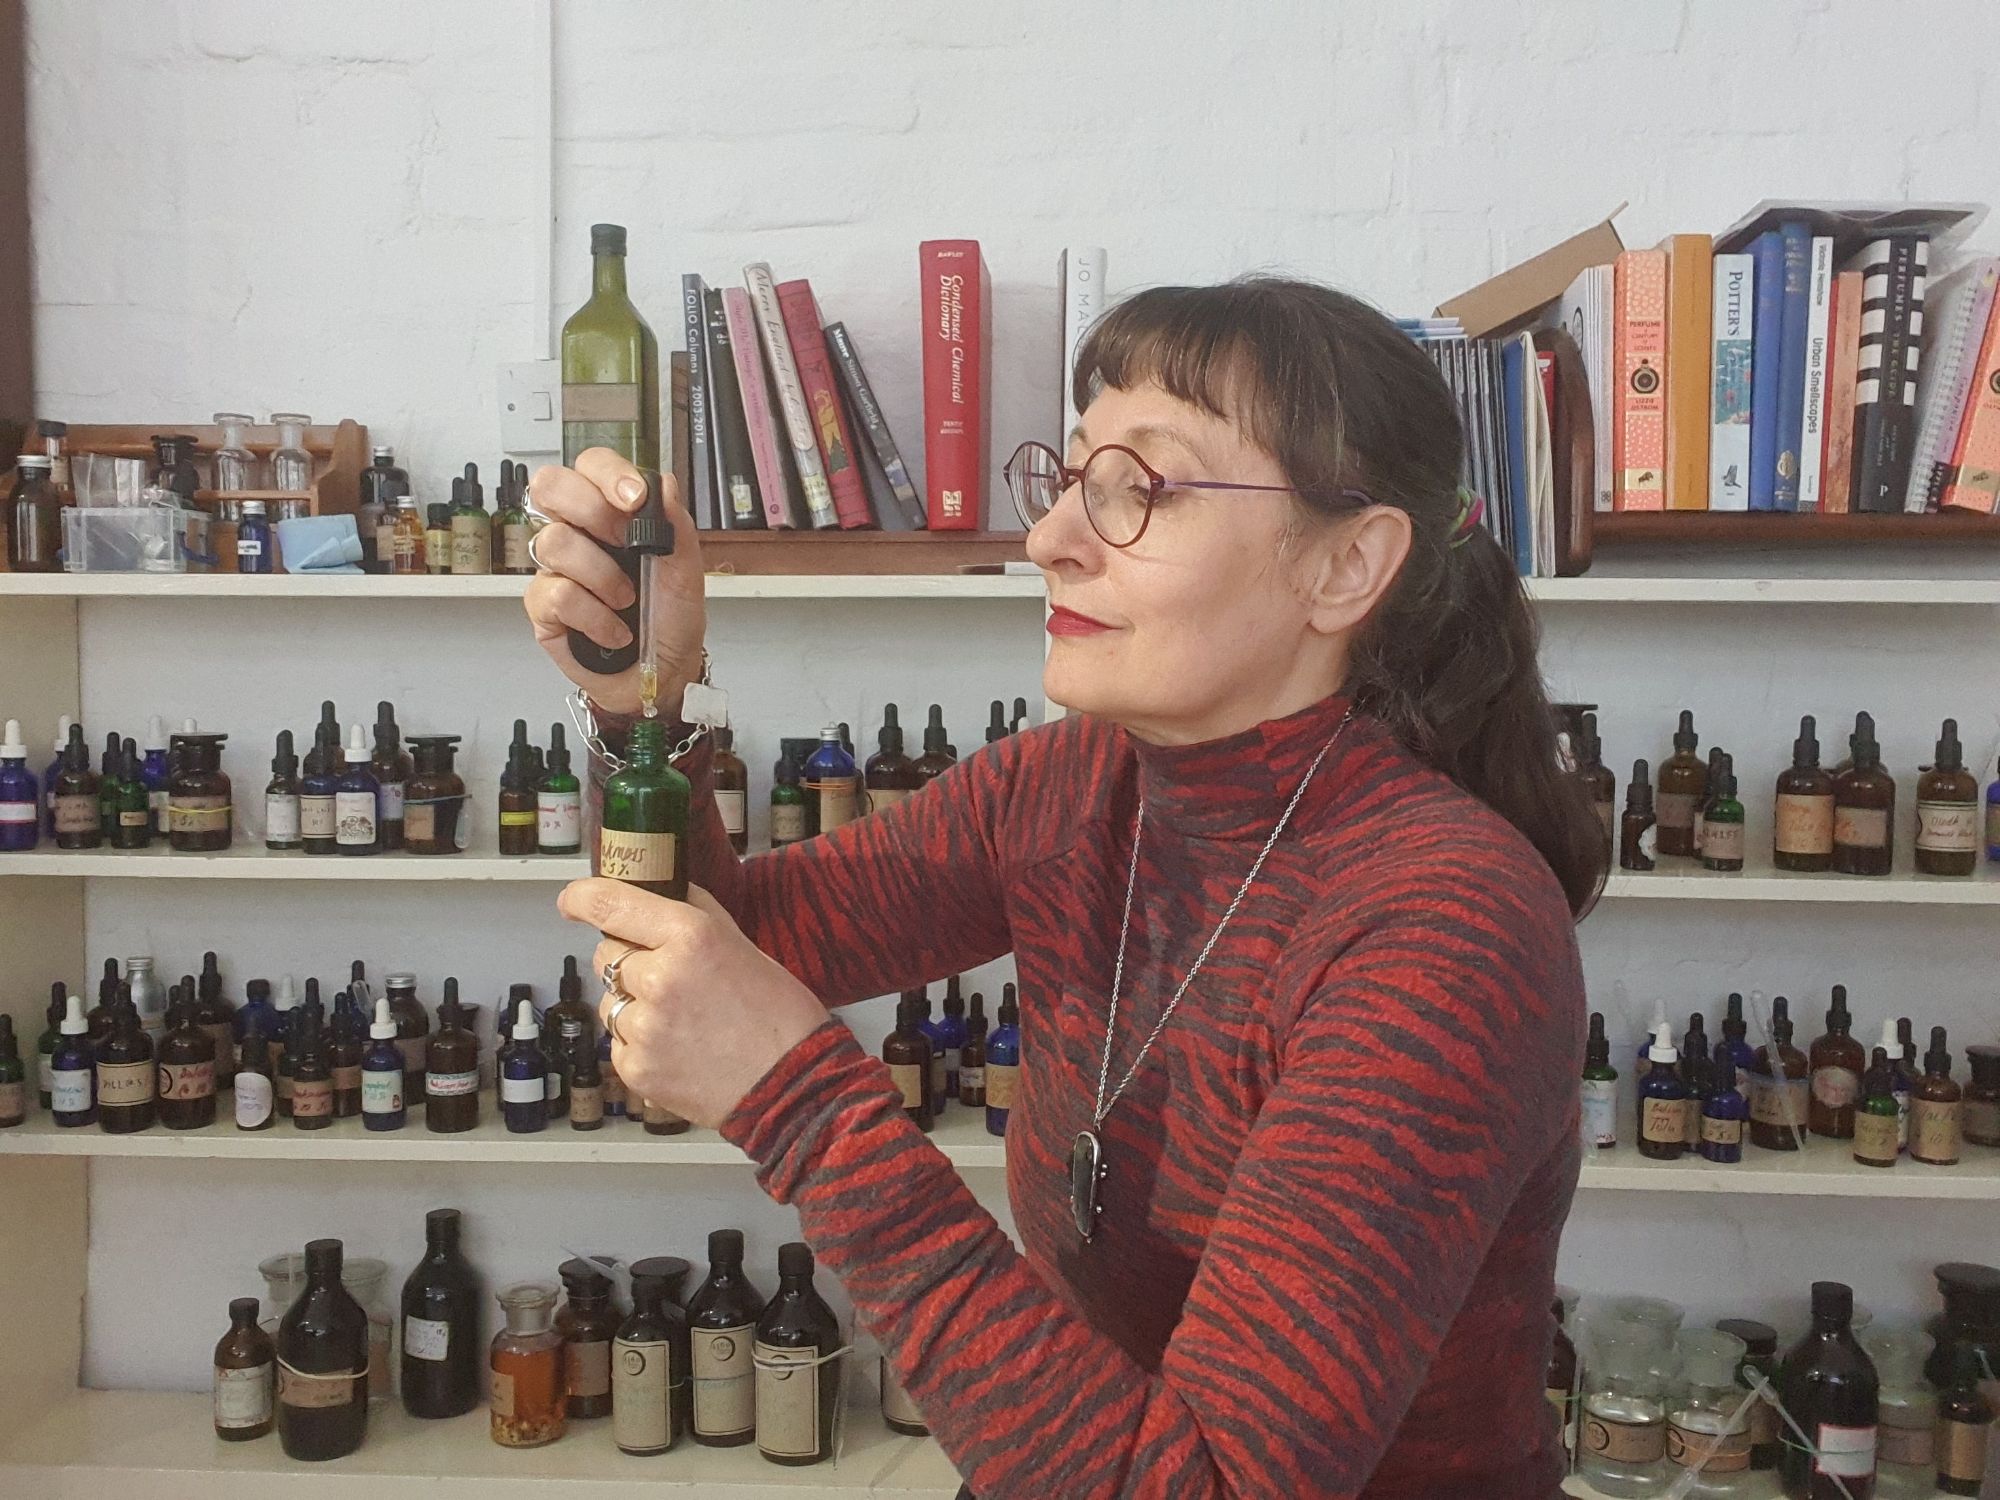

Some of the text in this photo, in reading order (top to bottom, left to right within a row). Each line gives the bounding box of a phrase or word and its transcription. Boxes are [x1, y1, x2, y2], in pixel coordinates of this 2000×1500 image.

[1078, 258, 1090, 282] JO
[1816, 244, 1827, 271] Victoria
[1894, 248, 1909, 322] PERFUMES
[939, 275, 953, 341] Dictionary
[1728, 271, 1744, 337] POTTER'S
[686, 289, 704, 444] FOLIO Columns 2003-2014
[951, 275, 964, 404] Condensed Chemical
[832, 328, 880, 424] Mauve Simon Garfield
[1806, 337, 1823, 434] Urban Smellscapes
[1887, 359, 1898, 397] GUIDE
